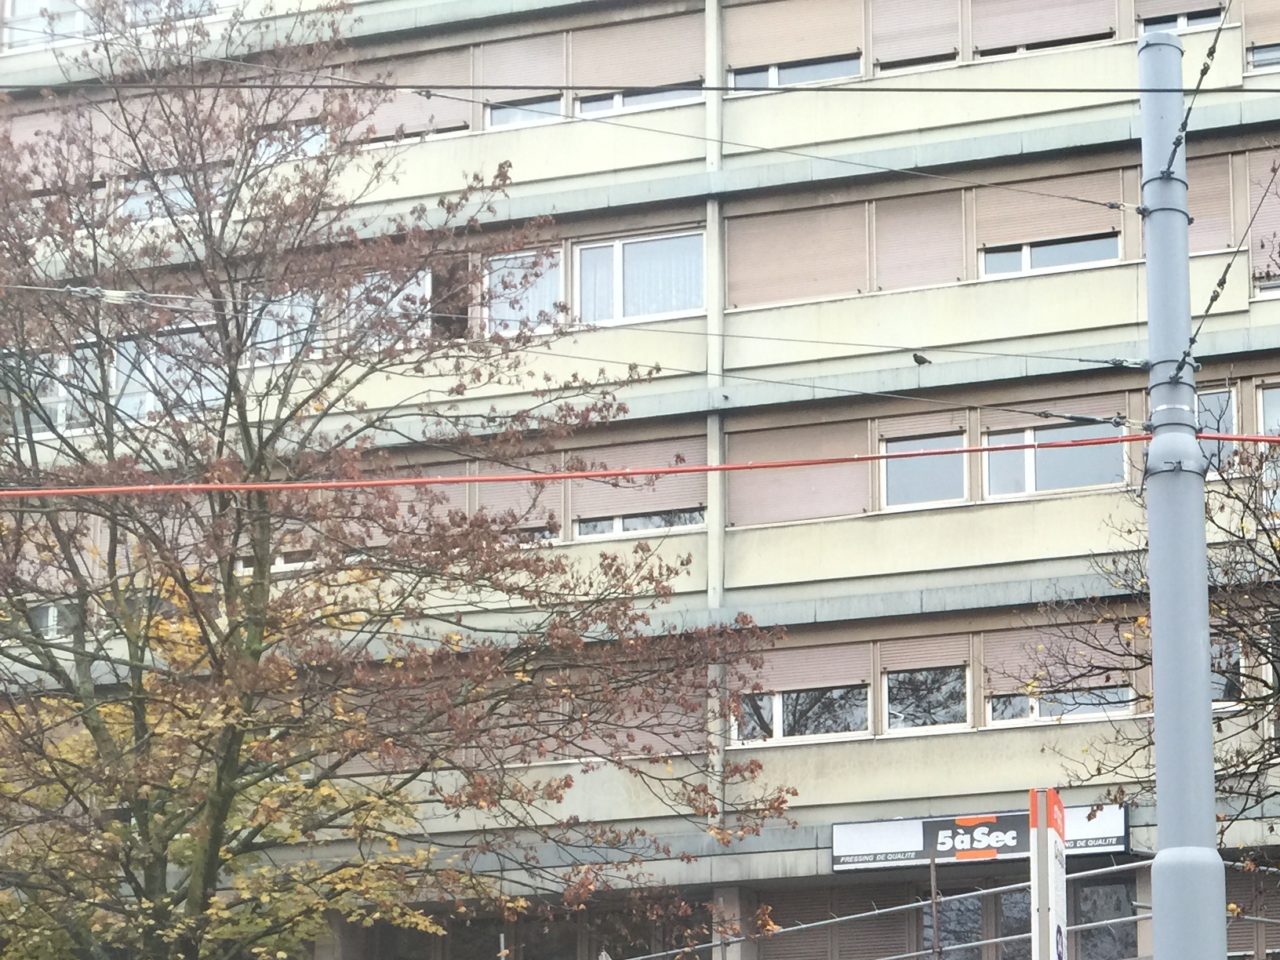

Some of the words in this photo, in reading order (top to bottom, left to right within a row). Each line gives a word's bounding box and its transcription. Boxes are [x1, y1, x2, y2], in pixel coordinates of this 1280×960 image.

[1076, 839, 1087, 848] DE
[1088, 837, 1118, 847] QUALITE
[839, 854, 874, 864] PRESSING
[887, 851, 916, 861] QUALITE
